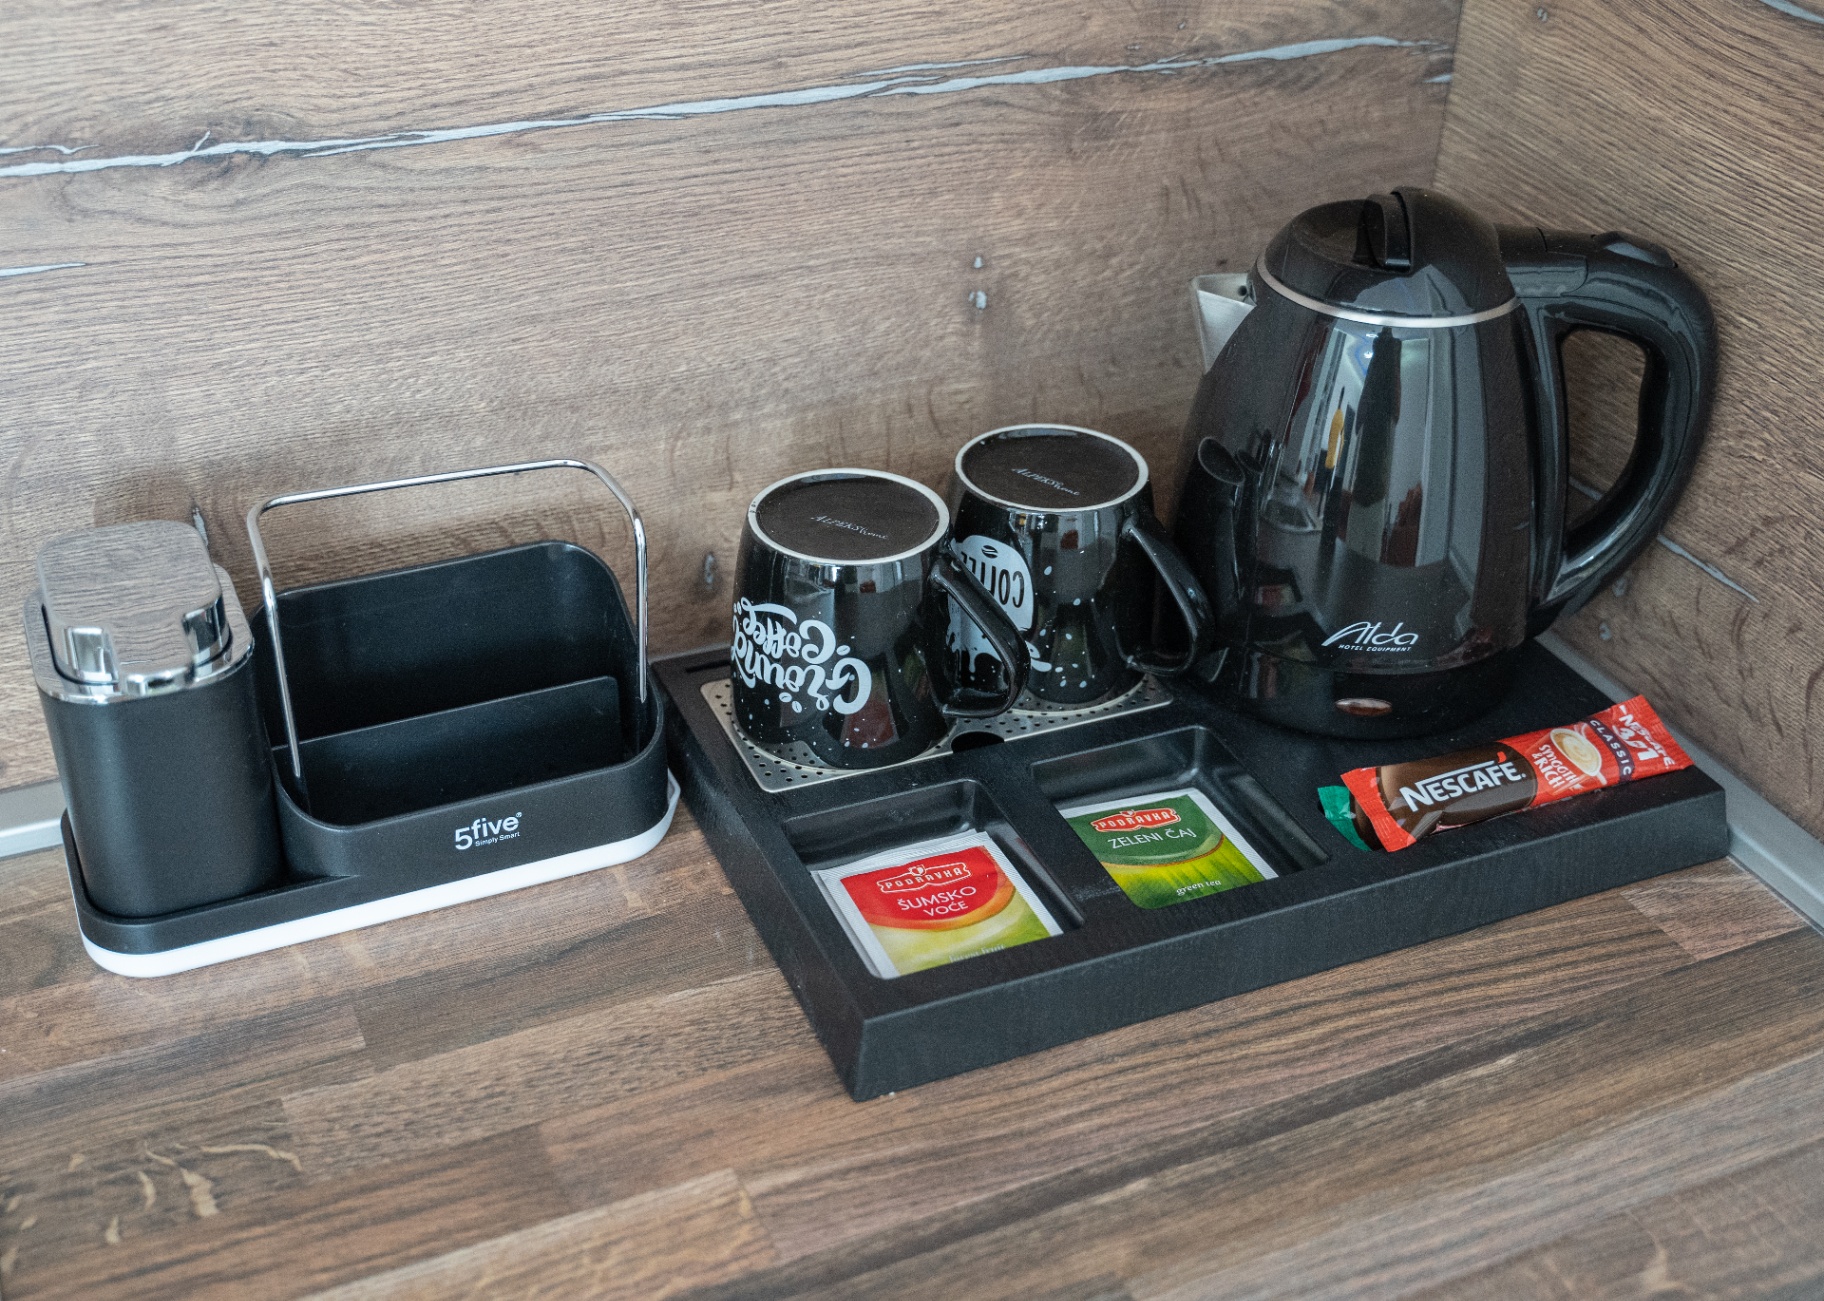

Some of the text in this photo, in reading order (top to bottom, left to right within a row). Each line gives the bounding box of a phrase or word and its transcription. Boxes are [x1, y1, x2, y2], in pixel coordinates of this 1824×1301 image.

[741, 597, 836, 664] Coffee
[1589, 719, 1632, 776] CLASSIC
[1534, 757, 1566, 789] RICH
[1098, 810, 1172, 829] PODRAVKA
[475, 831, 521, 847] Simply Smart
[1107, 827, 1197, 850] ZELENI ČAJ
[885, 867, 962, 889] PODRAVKA
[1176, 882, 1205, 896] green
[897, 886, 976, 911] ŠUMSKO
[923, 900, 968, 917] VOĆE
